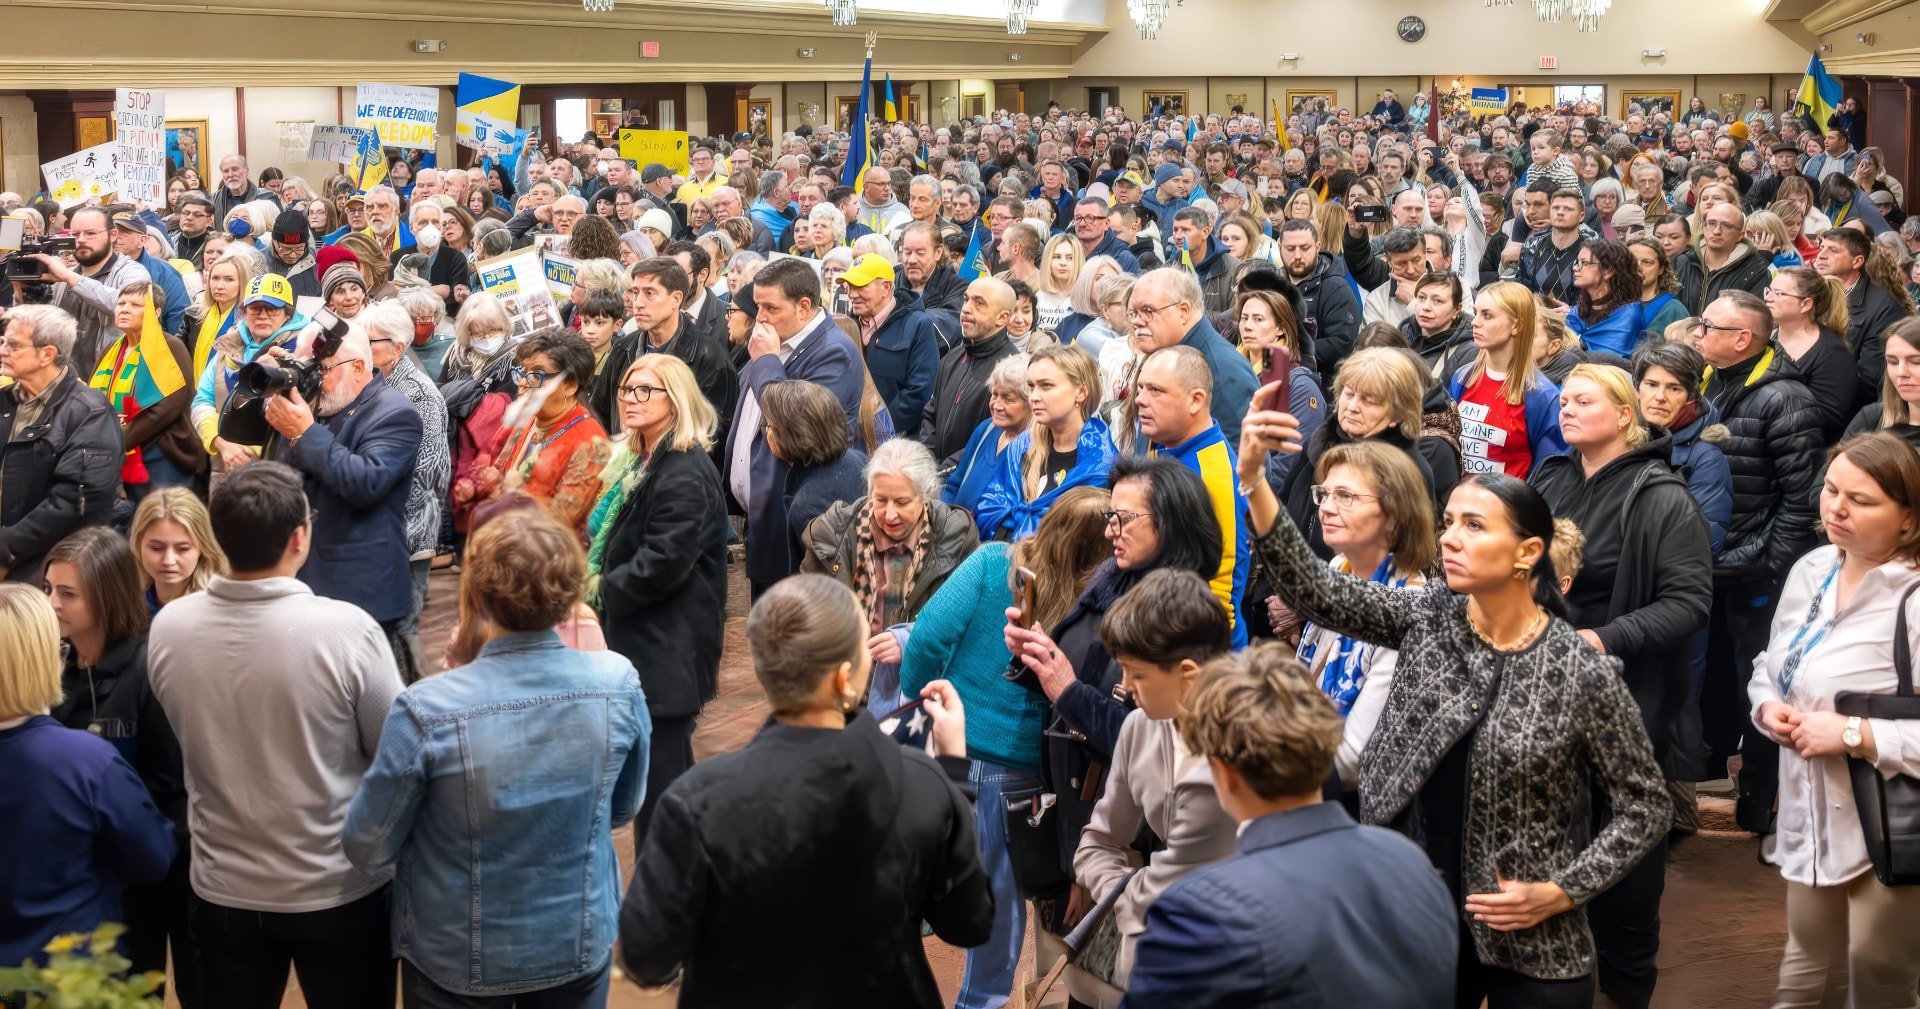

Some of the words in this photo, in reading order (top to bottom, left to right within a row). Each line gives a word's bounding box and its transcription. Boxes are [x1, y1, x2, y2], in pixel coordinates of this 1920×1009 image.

[127, 91, 151, 111] STOP
[357, 104, 375, 118] WE
[377, 105, 393, 118] ARE
[151, 114, 164, 130] UP
[547, 267, 558, 280] NO
[1461, 405, 1481, 418] AM
[1463, 421, 1496, 440] RAINE
[1460, 439, 1481, 454] IVE
